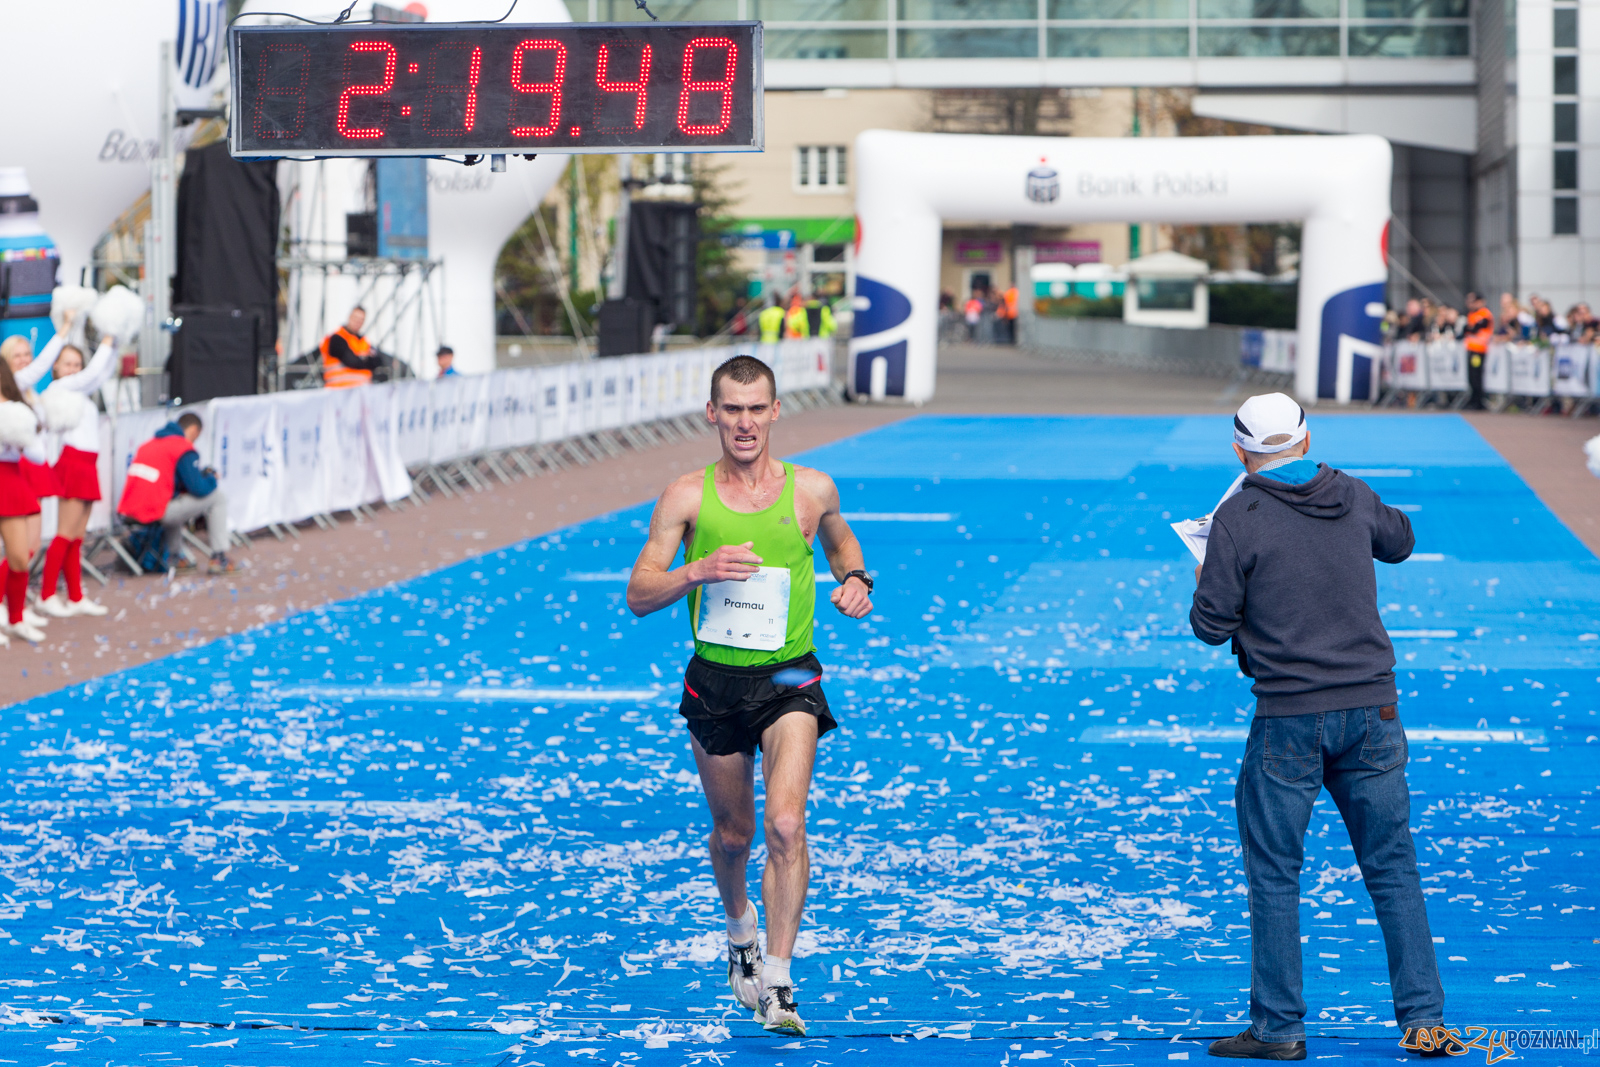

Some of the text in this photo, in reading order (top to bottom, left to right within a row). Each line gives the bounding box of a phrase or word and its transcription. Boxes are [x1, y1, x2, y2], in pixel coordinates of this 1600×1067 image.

[337, 37, 738, 139] 2:19.48
[1077, 171, 1143, 197] Bank
[1152, 170, 1229, 197] Polski
[724, 597, 765, 610] Pramau
